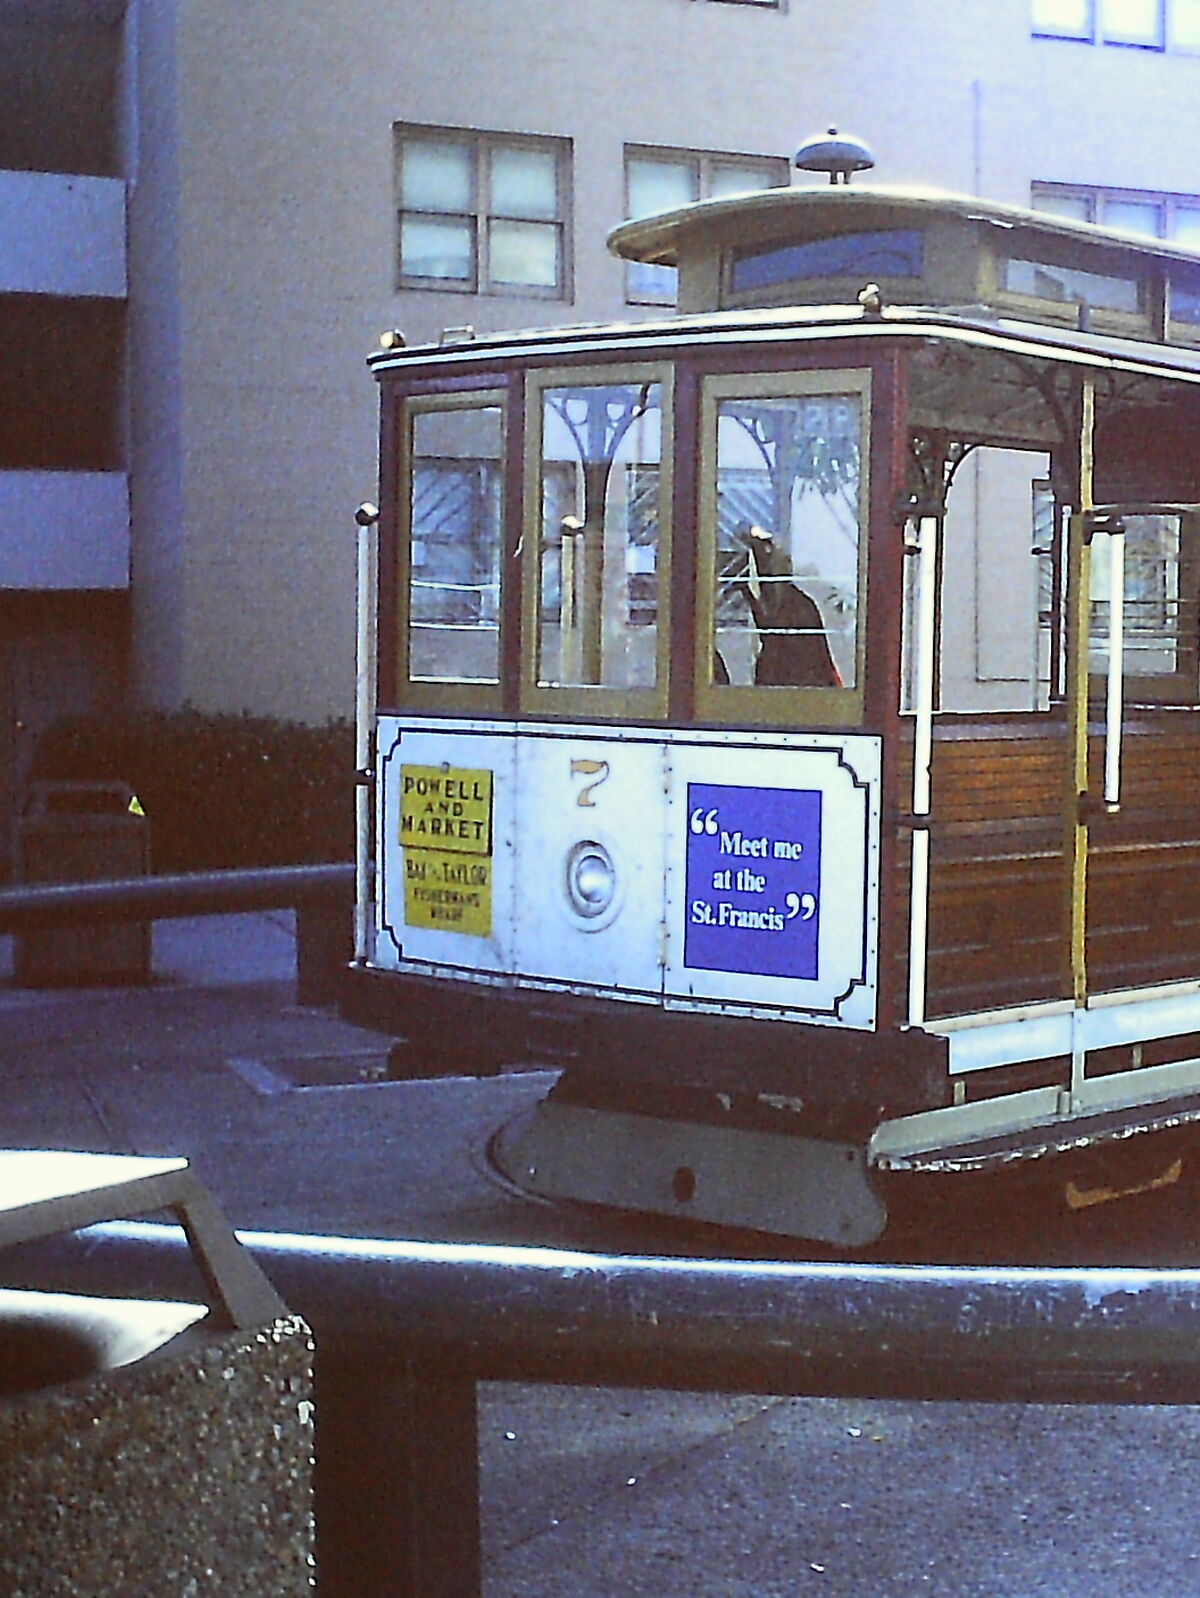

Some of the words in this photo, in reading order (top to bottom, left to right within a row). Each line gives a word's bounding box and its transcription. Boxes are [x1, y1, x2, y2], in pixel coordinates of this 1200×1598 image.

[403, 776, 484, 801] POWELL
[571, 758, 610, 807] 7
[424, 801, 464, 818] AND
[401, 814, 484, 841] MARKET
[773, 841, 802, 861] me
[713, 869, 732, 890] at
[736, 868, 766, 893] the
